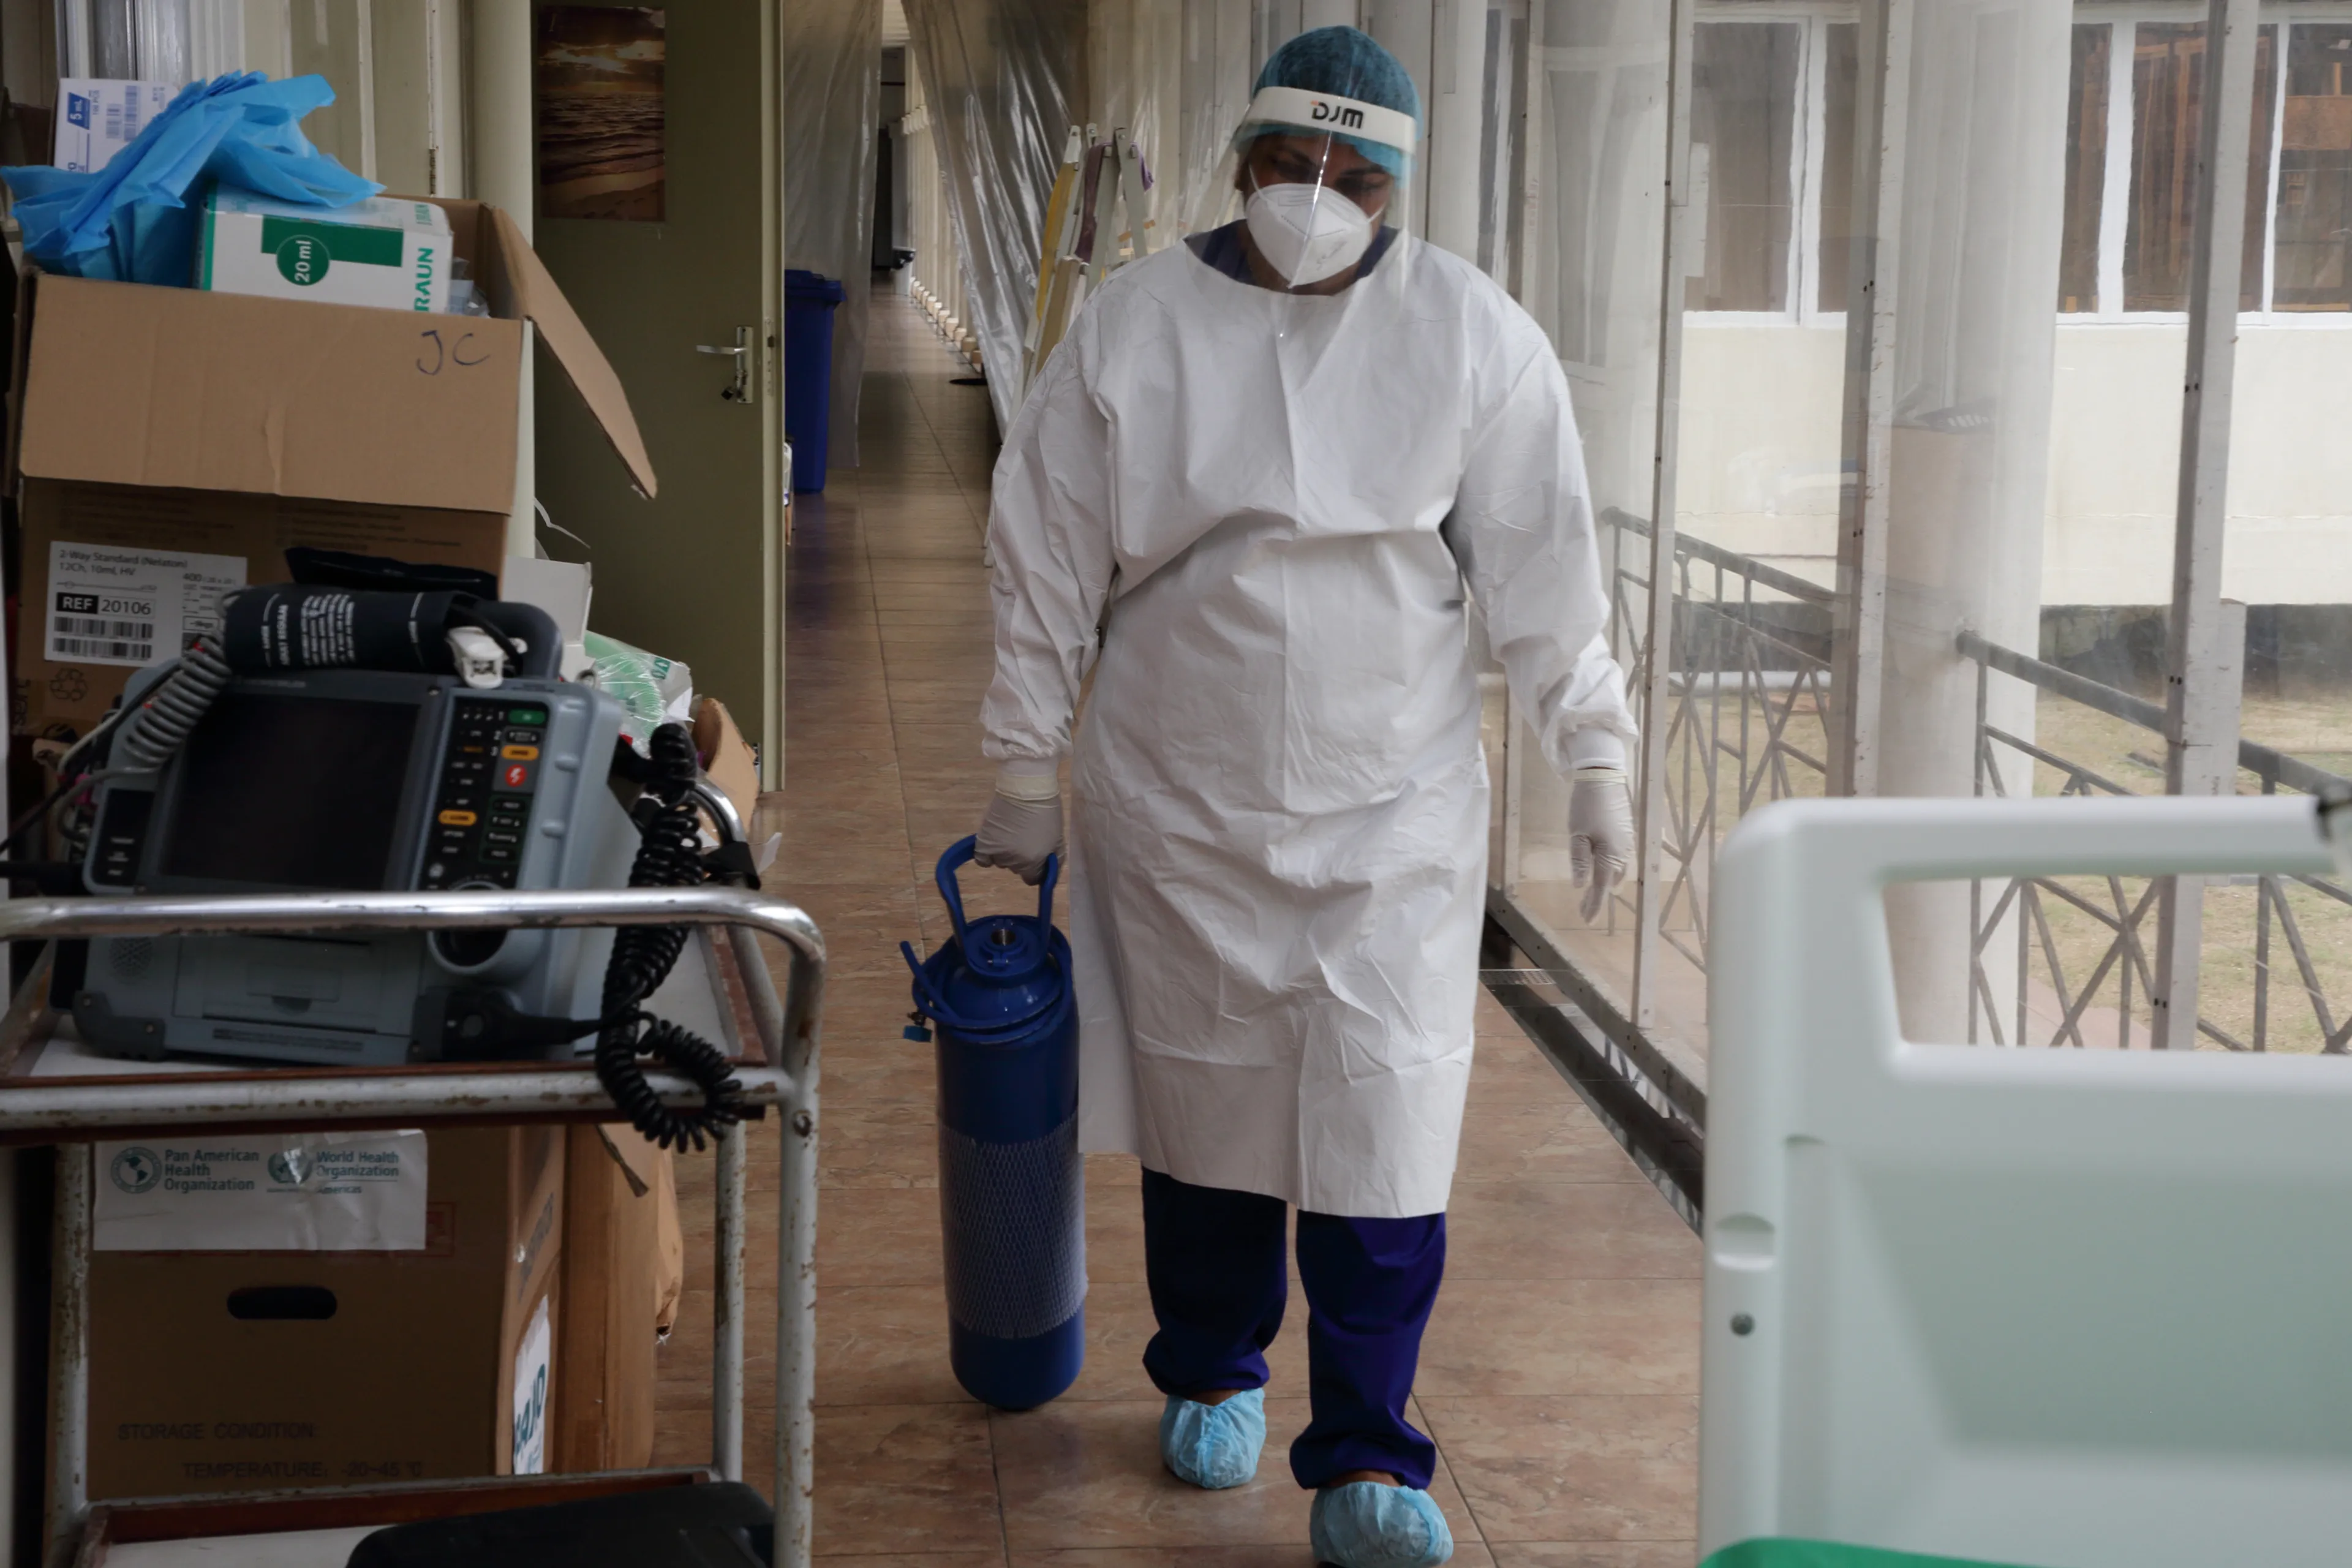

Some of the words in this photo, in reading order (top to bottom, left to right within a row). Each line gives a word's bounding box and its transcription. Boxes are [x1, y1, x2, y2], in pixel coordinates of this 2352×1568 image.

[294, 239, 312, 260] ml
[295, 261, 311, 283] 20
[92, 551, 140, 565] Standard
[62, 597, 94, 610] REF
[101, 598, 151, 615] 20106
[164, 1148, 189, 1163] Pan
[193, 1147, 260, 1163] American
[315, 1150, 354, 1164] World
[358, 1150, 399, 1164] Health
[164, 1162, 211, 1177] Health
[316, 1164, 399, 1180] Organization
[164, 1177, 255, 1194] Organization
[118, 1423, 205, 1441] STORAGE
